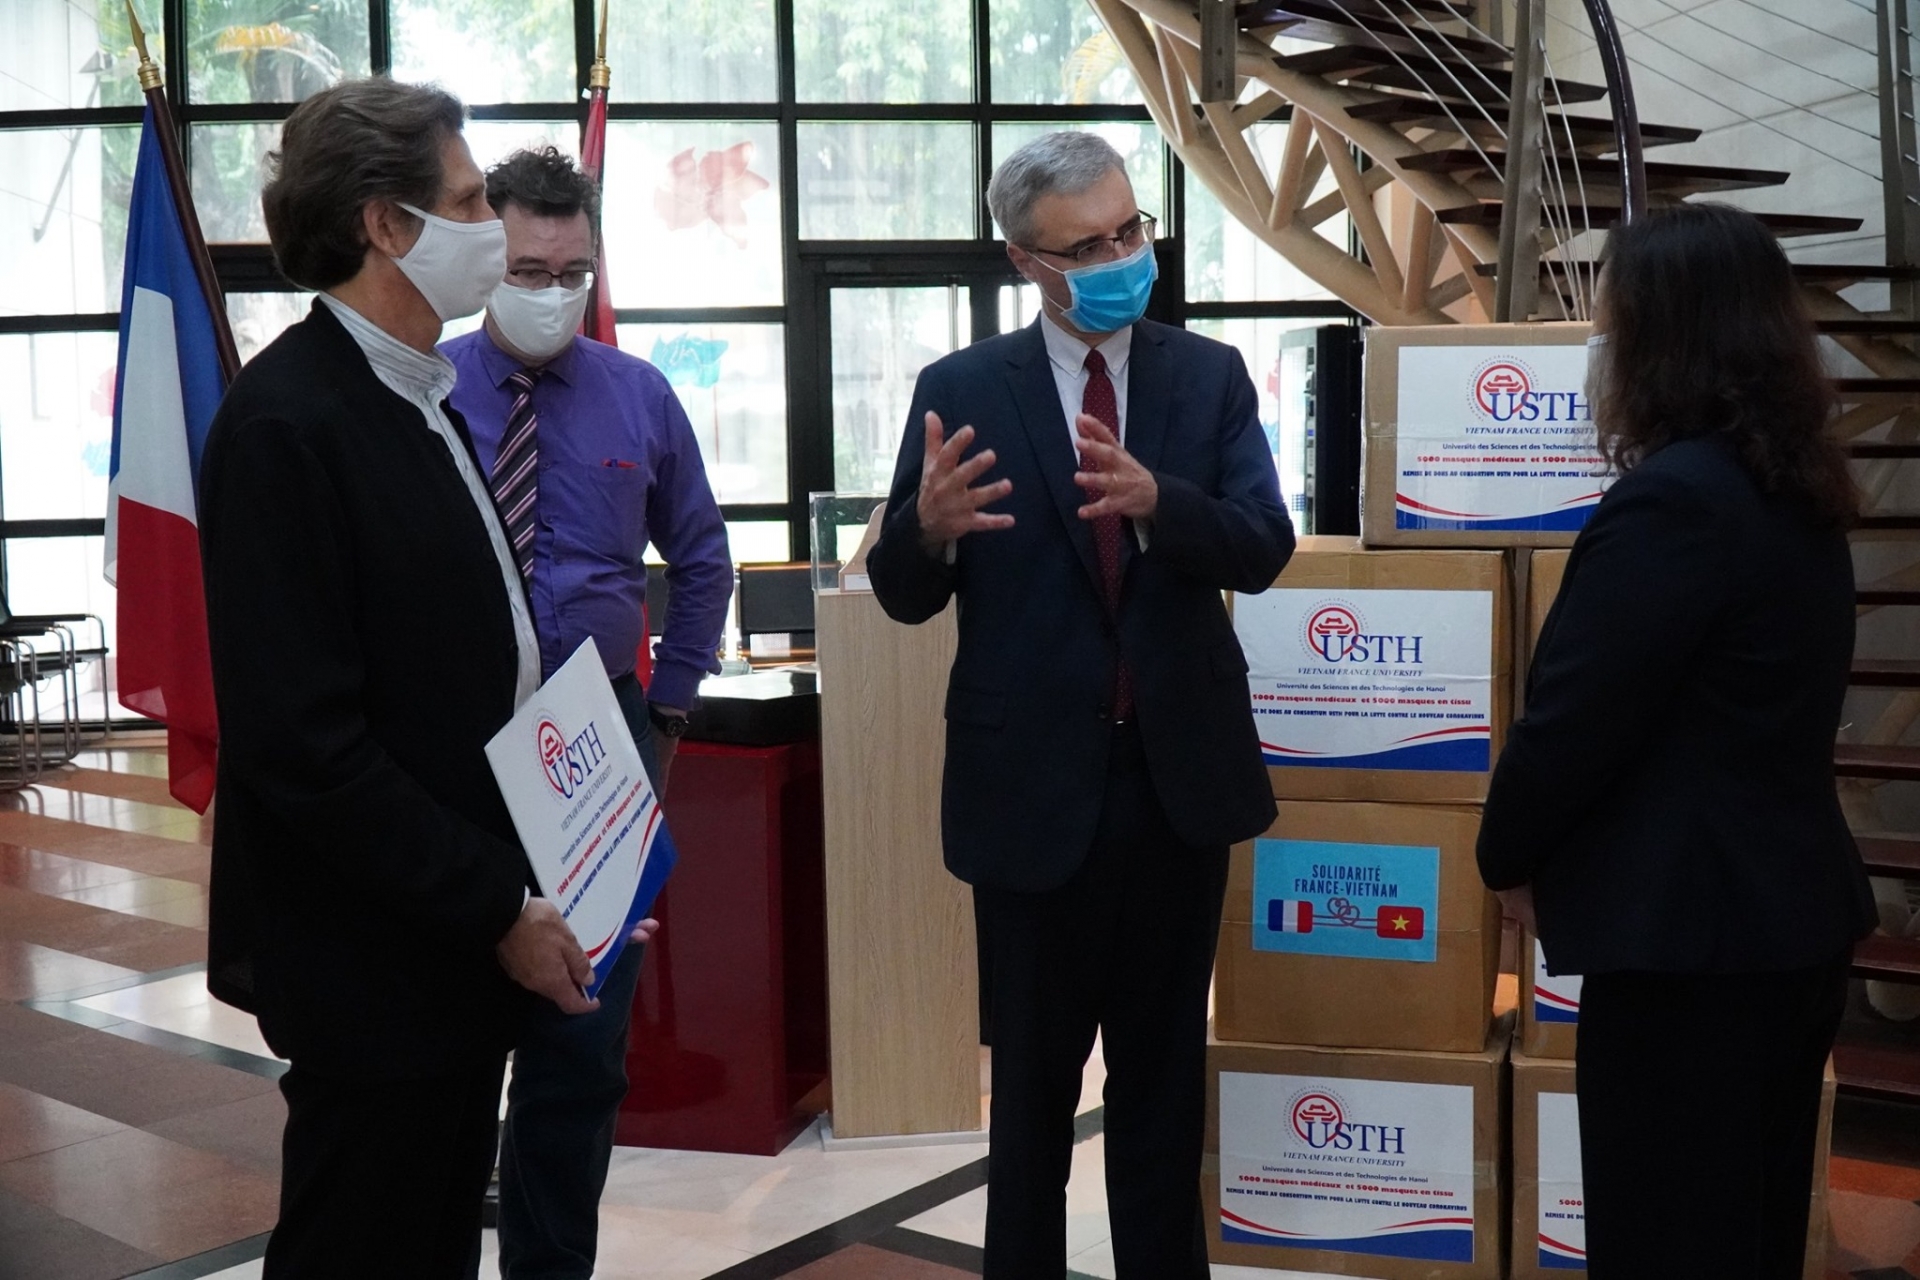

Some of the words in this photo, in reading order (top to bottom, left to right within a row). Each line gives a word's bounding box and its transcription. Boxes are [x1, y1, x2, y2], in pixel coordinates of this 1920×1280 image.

[1489, 391, 1592, 421] USTH
[1543, 427, 1594, 435] UNIVERSITY
[1543, 443, 1585, 451] Technologies
[1320, 634, 1423, 664] USTH
[1373, 669, 1423, 677] UNIVERSITY
[1315, 695, 1356, 703] médicaux
[551, 721, 606, 799] USTH
[1312, 864, 1381, 882] SOLIDARITÉ
[1294, 878, 1398, 898] FRANCE-VIETNAM
[1305, 1121, 1405, 1154] USTH
[1283, 1151, 1320, 1161] VIETNAM
[1322, 1155, 1355, 1163] FRANCE
[1356, 1158, 1406, 1167] UNIVERSITY
[1262, 1165, 1294, 1173] Université
[1307, 1169, 1334, 1177] Sciences
[1356, 1172, 1397, 1182] Technologies
[1262, 1178, 1299, 1186] masques
[1300, 1180, 1341, 1189] médicaux
[1381, 1186, 1418, 1195] masques
[1433, 1189, 1453, 1197] tissu
